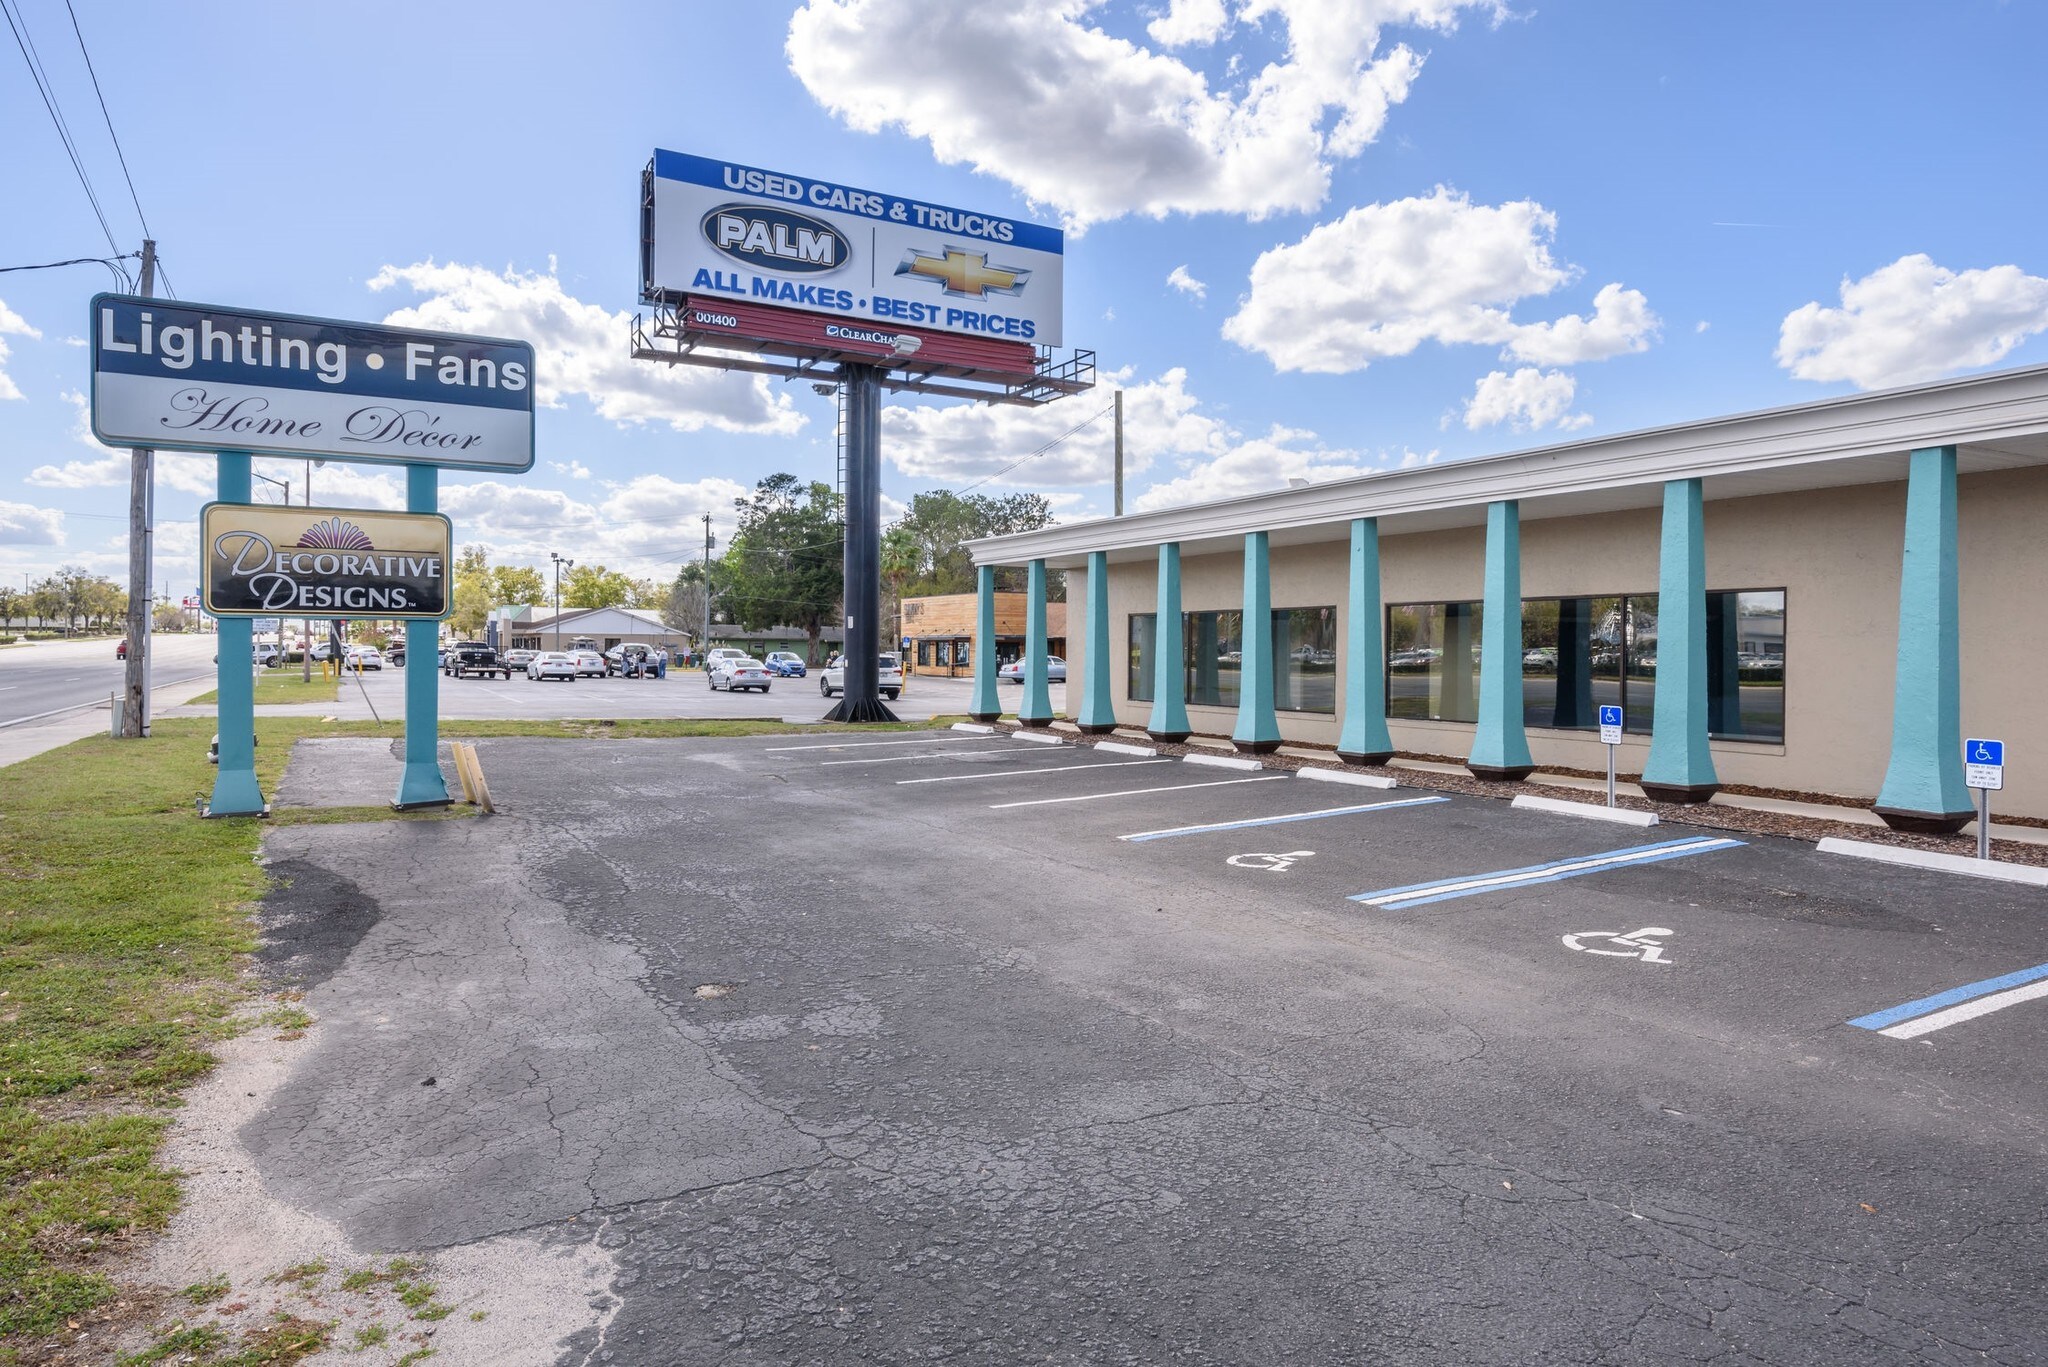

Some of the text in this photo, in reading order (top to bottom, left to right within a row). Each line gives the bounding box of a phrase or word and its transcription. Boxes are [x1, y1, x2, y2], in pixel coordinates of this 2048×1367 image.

[723, 166, 1014, 242] USED CARS & TRUCKS
[717, 213, 836, 267] PALM
[692, 269, 1036, 338] ALL MAKES BEST PRICES
[696, 312, 737, 327] 001400
[101, 308, 527, 392] Lighting Fans
[160, 387, 323, 438] Home
[214, 531, 441, 578] DECORATIVE
